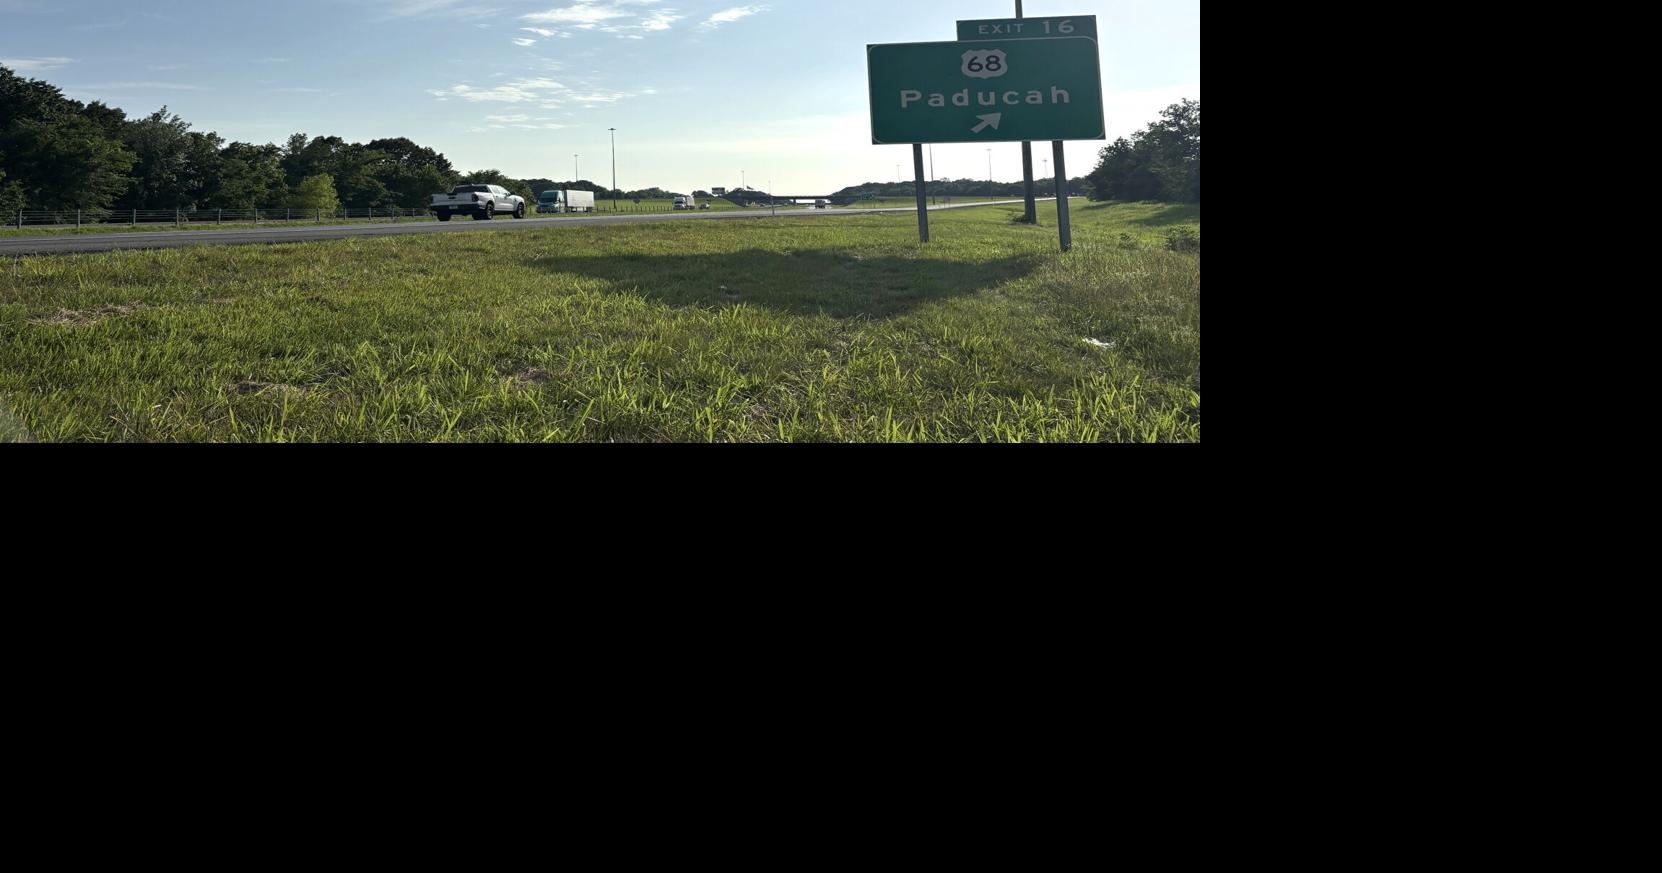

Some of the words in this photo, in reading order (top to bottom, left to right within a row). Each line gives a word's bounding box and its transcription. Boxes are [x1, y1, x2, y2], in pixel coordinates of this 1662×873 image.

[978, 24, 1024, 34] EXIT
[1042, 20, 1075, 34] 16
[967, 55, 1002, 72] 68
[900, 86, 1070, 108] Paducah
